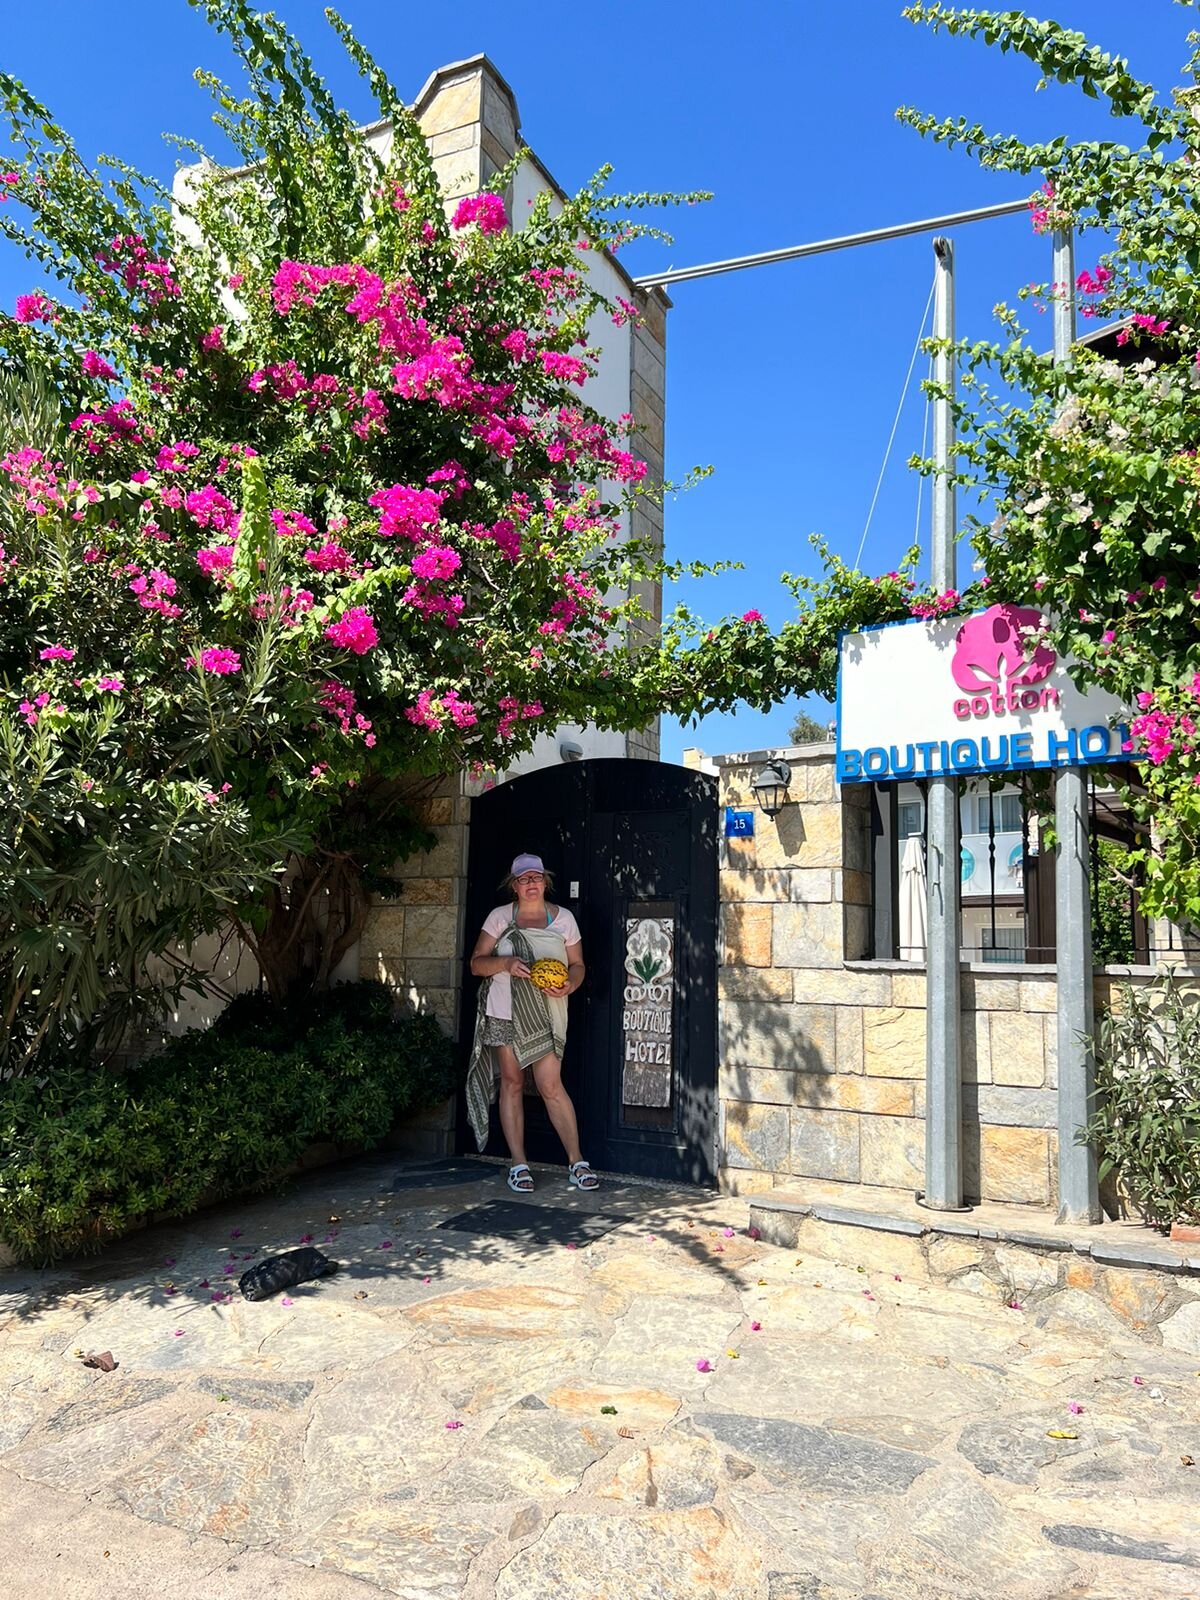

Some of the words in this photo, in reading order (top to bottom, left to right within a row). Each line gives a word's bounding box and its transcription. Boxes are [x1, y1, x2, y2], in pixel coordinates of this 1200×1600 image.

[954, 683, 1060, 717] cotton
[841, 732, 1033, 778] BOUTIQUE
[734, 819, 746, 830] 15
[623, 1010, 672, 1034] BOUTIQUE
[626, 1041, 671, 1065] HOTEL
